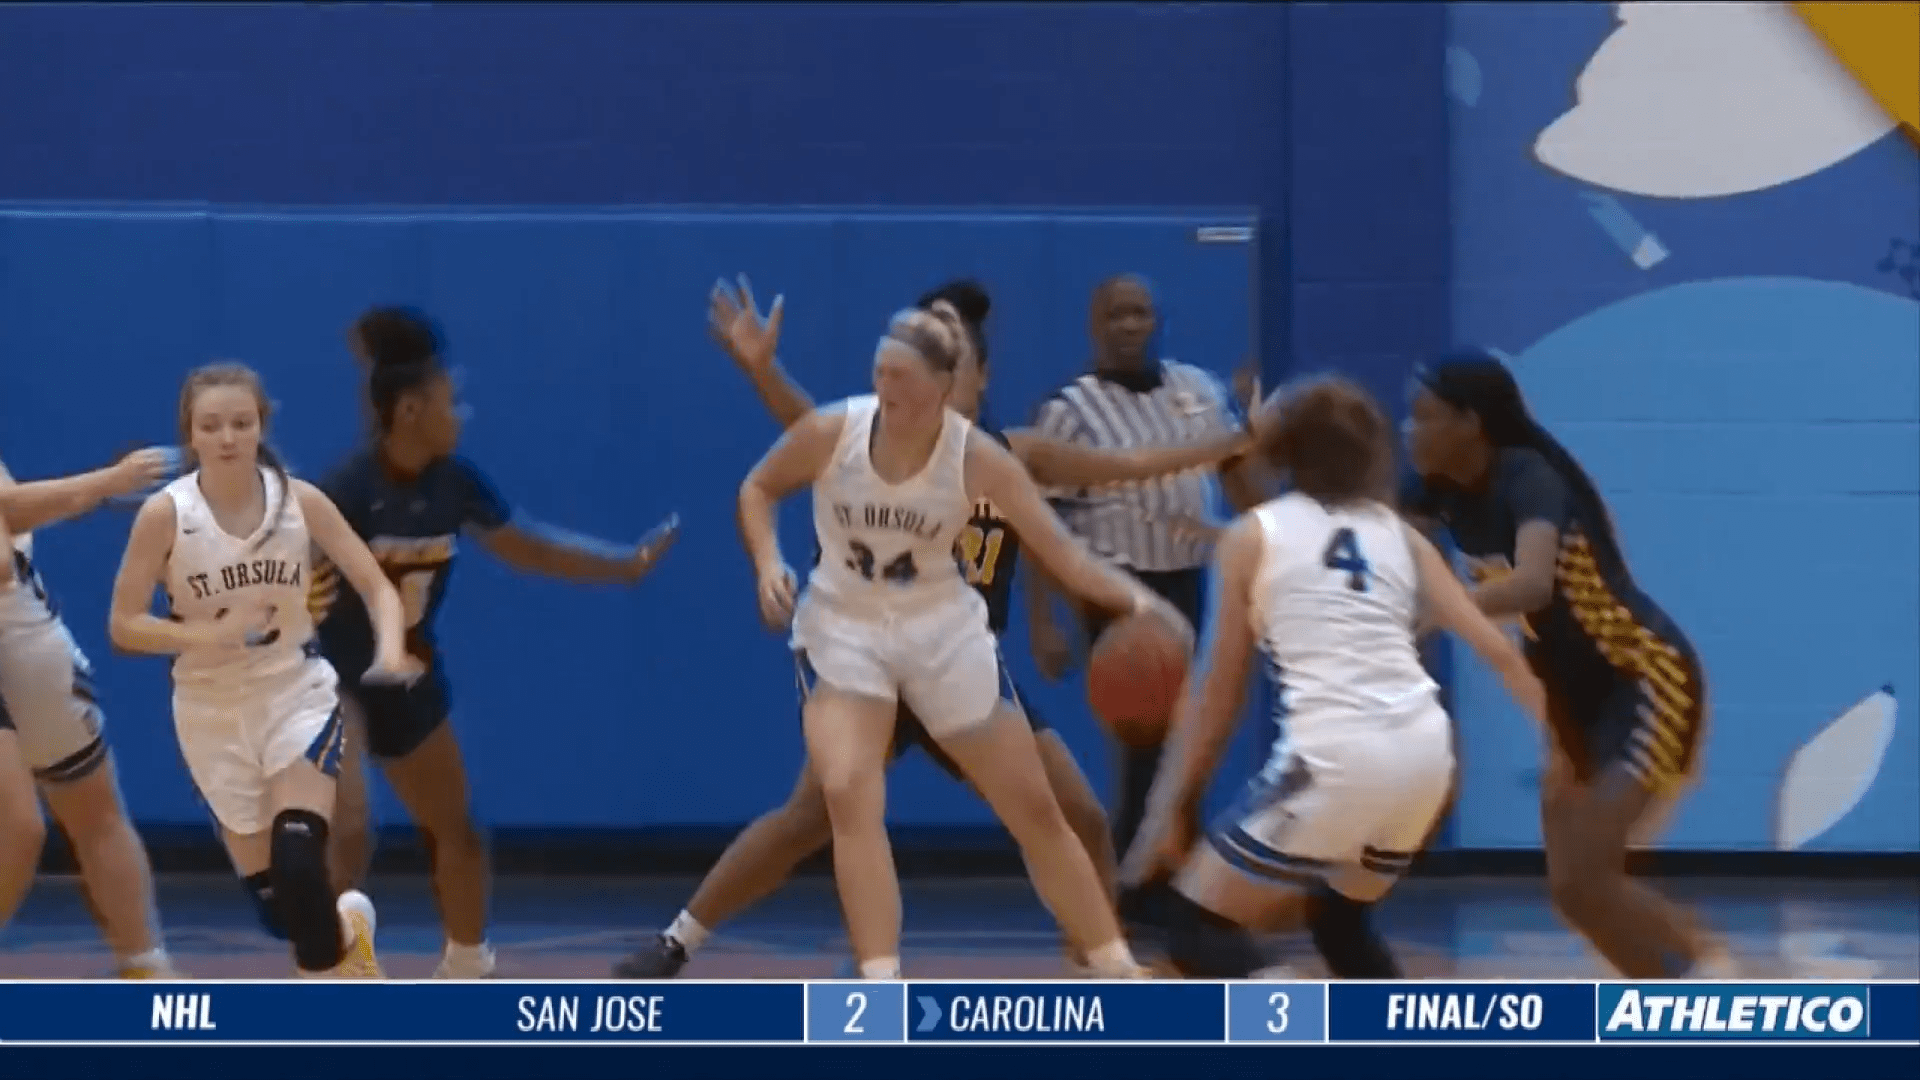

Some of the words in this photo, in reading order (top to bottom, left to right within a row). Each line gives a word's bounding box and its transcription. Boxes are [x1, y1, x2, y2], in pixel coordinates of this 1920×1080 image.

[186, 572, 220, 600] ST.
[221, 559, 301, 590] URSULA
[845, 538, 918, 581] 34
[1322, 526, 1369, 593] 4
